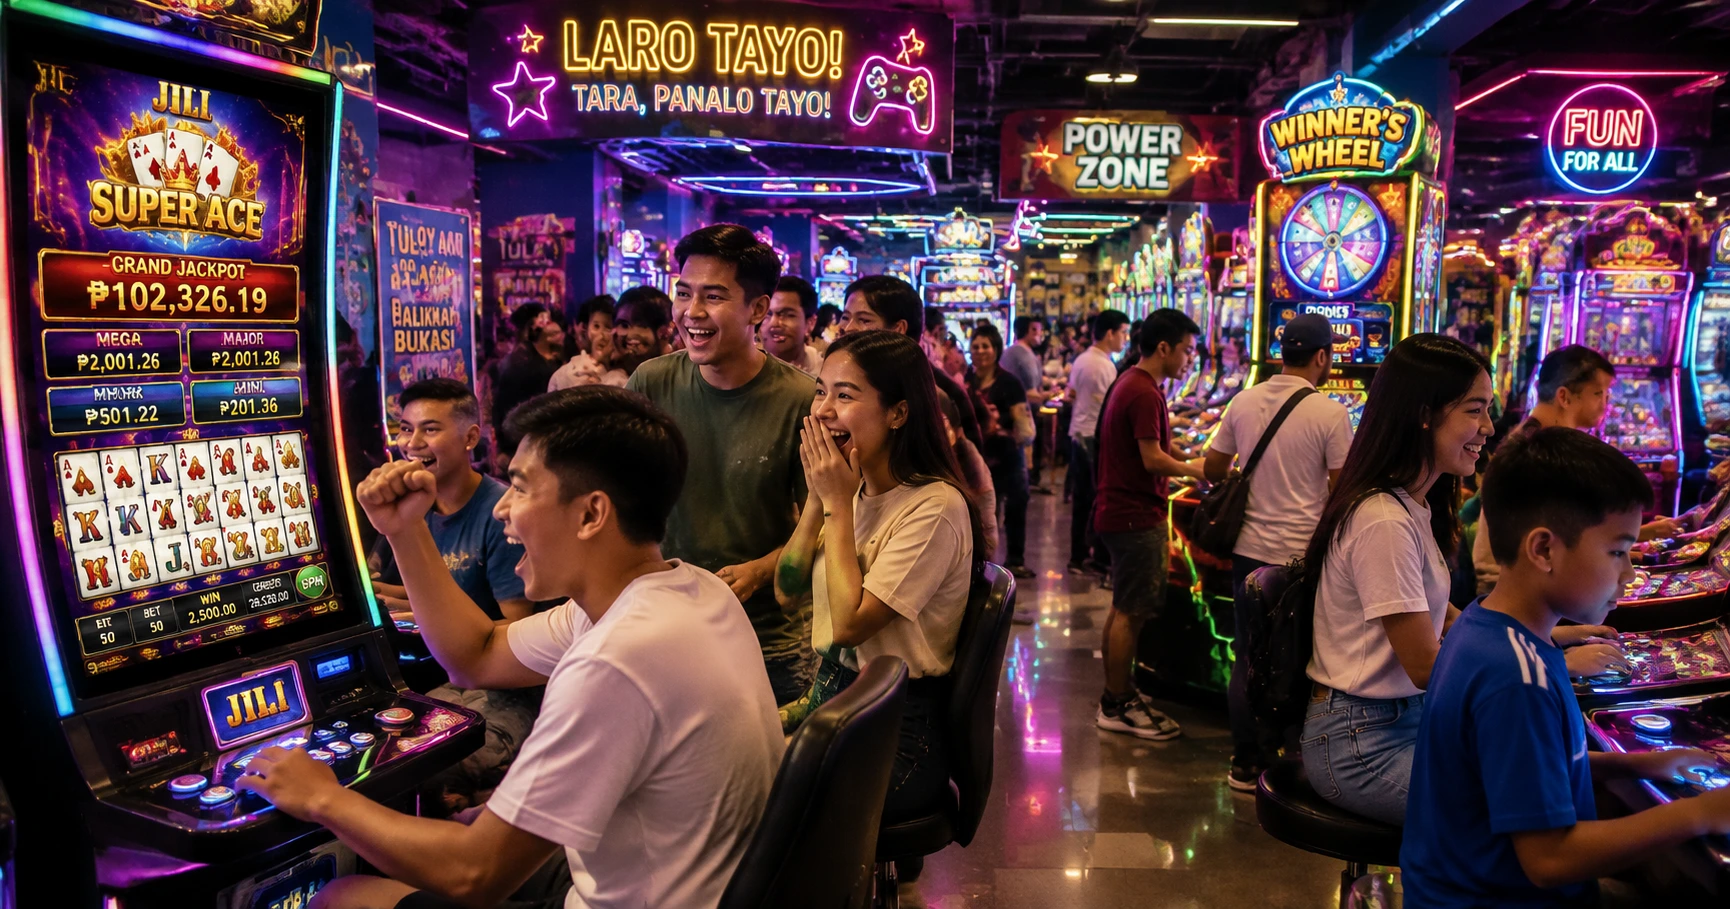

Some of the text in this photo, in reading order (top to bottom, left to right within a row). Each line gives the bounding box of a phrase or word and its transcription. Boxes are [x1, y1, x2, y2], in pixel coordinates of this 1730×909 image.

[563, 19, 844, 80] LARO TAYO!
[152, 80, 213, 122] JILI
[572, 84, 832, 119] TARA, PANALO TAYO!
[1062, 121, 1184, 157] POWER
[1270, 105, 1409, 149] WINNER'S
[1564, 108, 1645, 147] FUN
[1074, 155, 1170, 189] ZONE
[1288, 137, 1387, 173] WHEEL
[1562, 151, 1639, 172] FOR ALL
[90, 180, 265, 238] SUPER ACE
[111, 255, 246, 280] GRAND JACKPOT
[87, 280, 267, 315] ₱102,326.19
[223, 332, 264, 345] MAJOR
[146, 452, 172, 485] K
[73, 509, 104, 544] K
[115, 503, 144, 536] K
[143, 605, 161, 619] BET
[187, 603, 237, 625] 2,500.00
[200, 591, 221, 606] WIN
[99, 632, 116, 645] 50
[150, 620, 164, 633] 50
[225, 679, 290, 728] JILI
